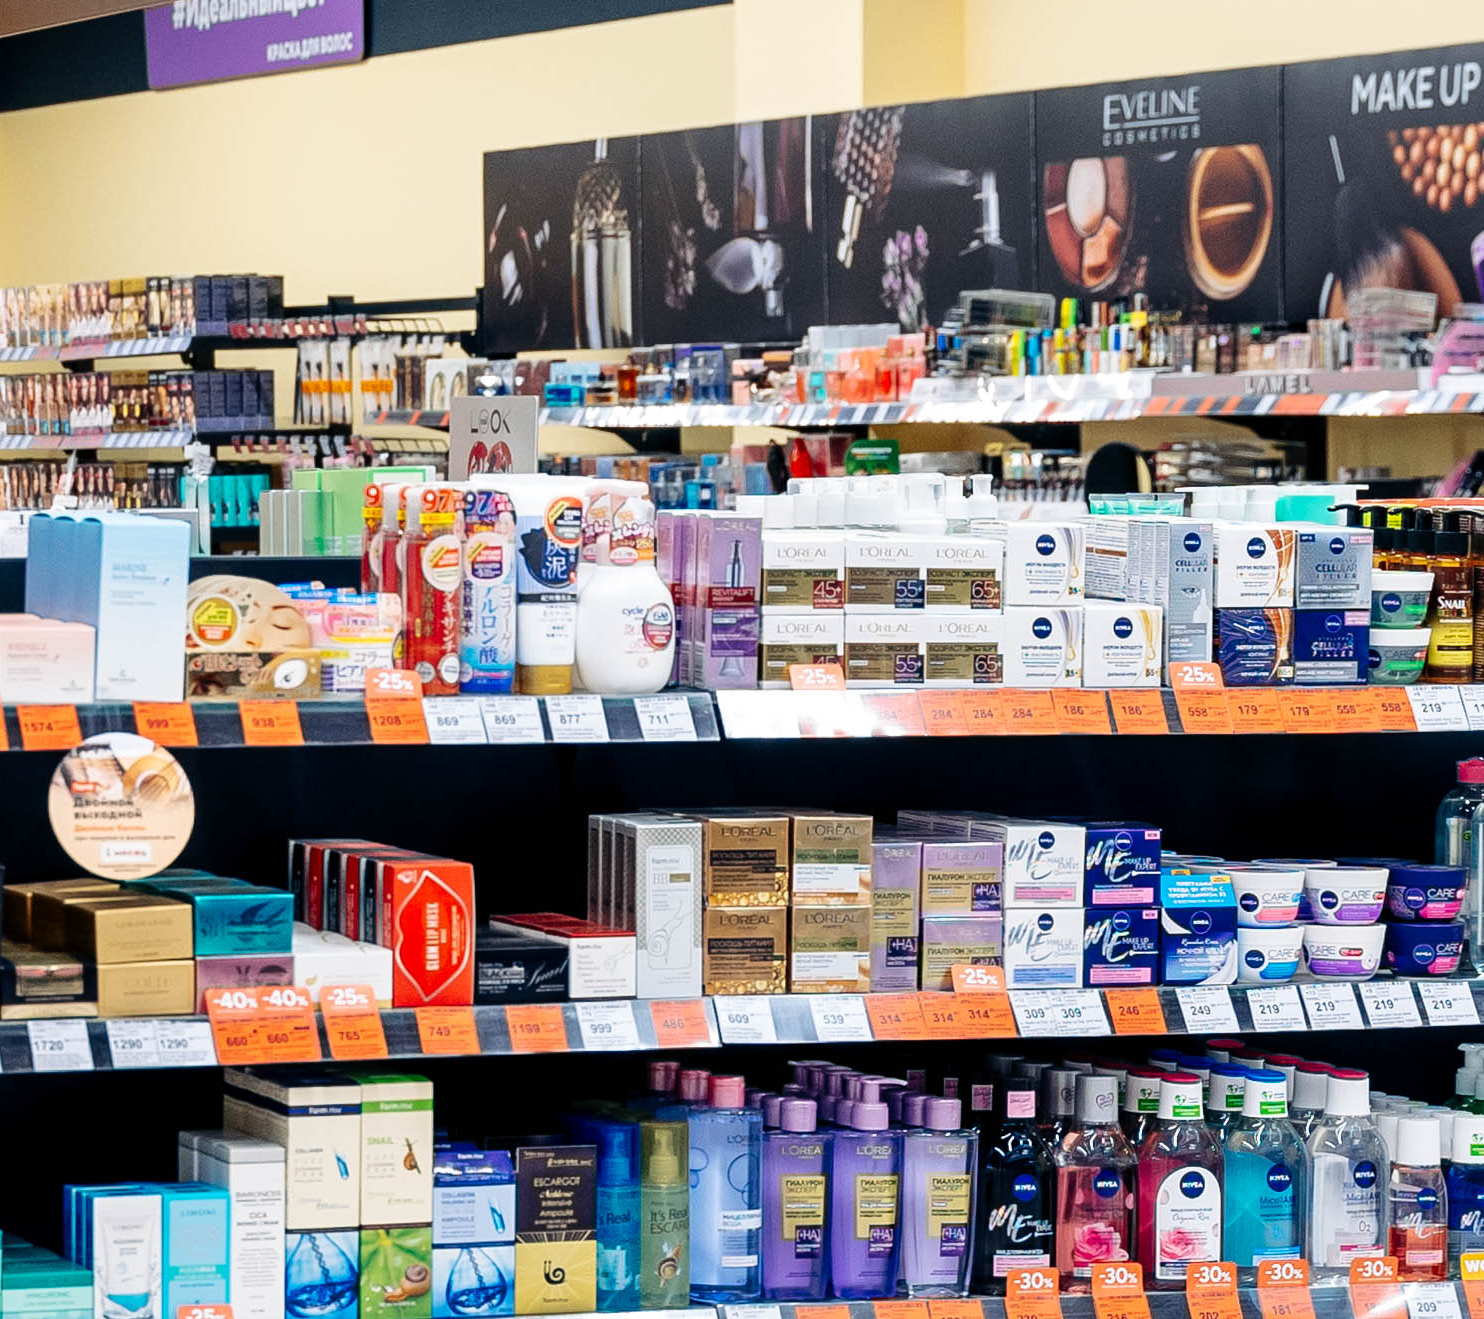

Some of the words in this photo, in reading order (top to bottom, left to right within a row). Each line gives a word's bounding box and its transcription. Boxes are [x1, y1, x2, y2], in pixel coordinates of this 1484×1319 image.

[267, 41, 300, 62] КРАСКА
[321, 32, 353, 54] ВОЛОС
[1350, 64, 1434, 115] MAKE
[1439, 61, 1481, 105] UP
[1102, 85, 1201, 131] EVELINE
[1102, 126, 1201, 146] COSMETICS
[896, 581, 924, 599] 55+
[972, 581, 1003, 599] 65+
[1262, 893, 1292, 904] CARE
[1427, 889, 1456, 901] CARE
[959, 968, 997, 987] -25%
[212, 992, 258, 1010] -40%
[261, 991, 309, 1009] -40%
[1015, 1182, 1036, 1191] NIVEA
[1096, 1181, 1118, 1189] NIVEA
[1182, 1181, 1204, 1189] NIVEA
[1013, 1272, 1053, 1290] -30%
[1194, 1265, 1232, 1284] -30%
